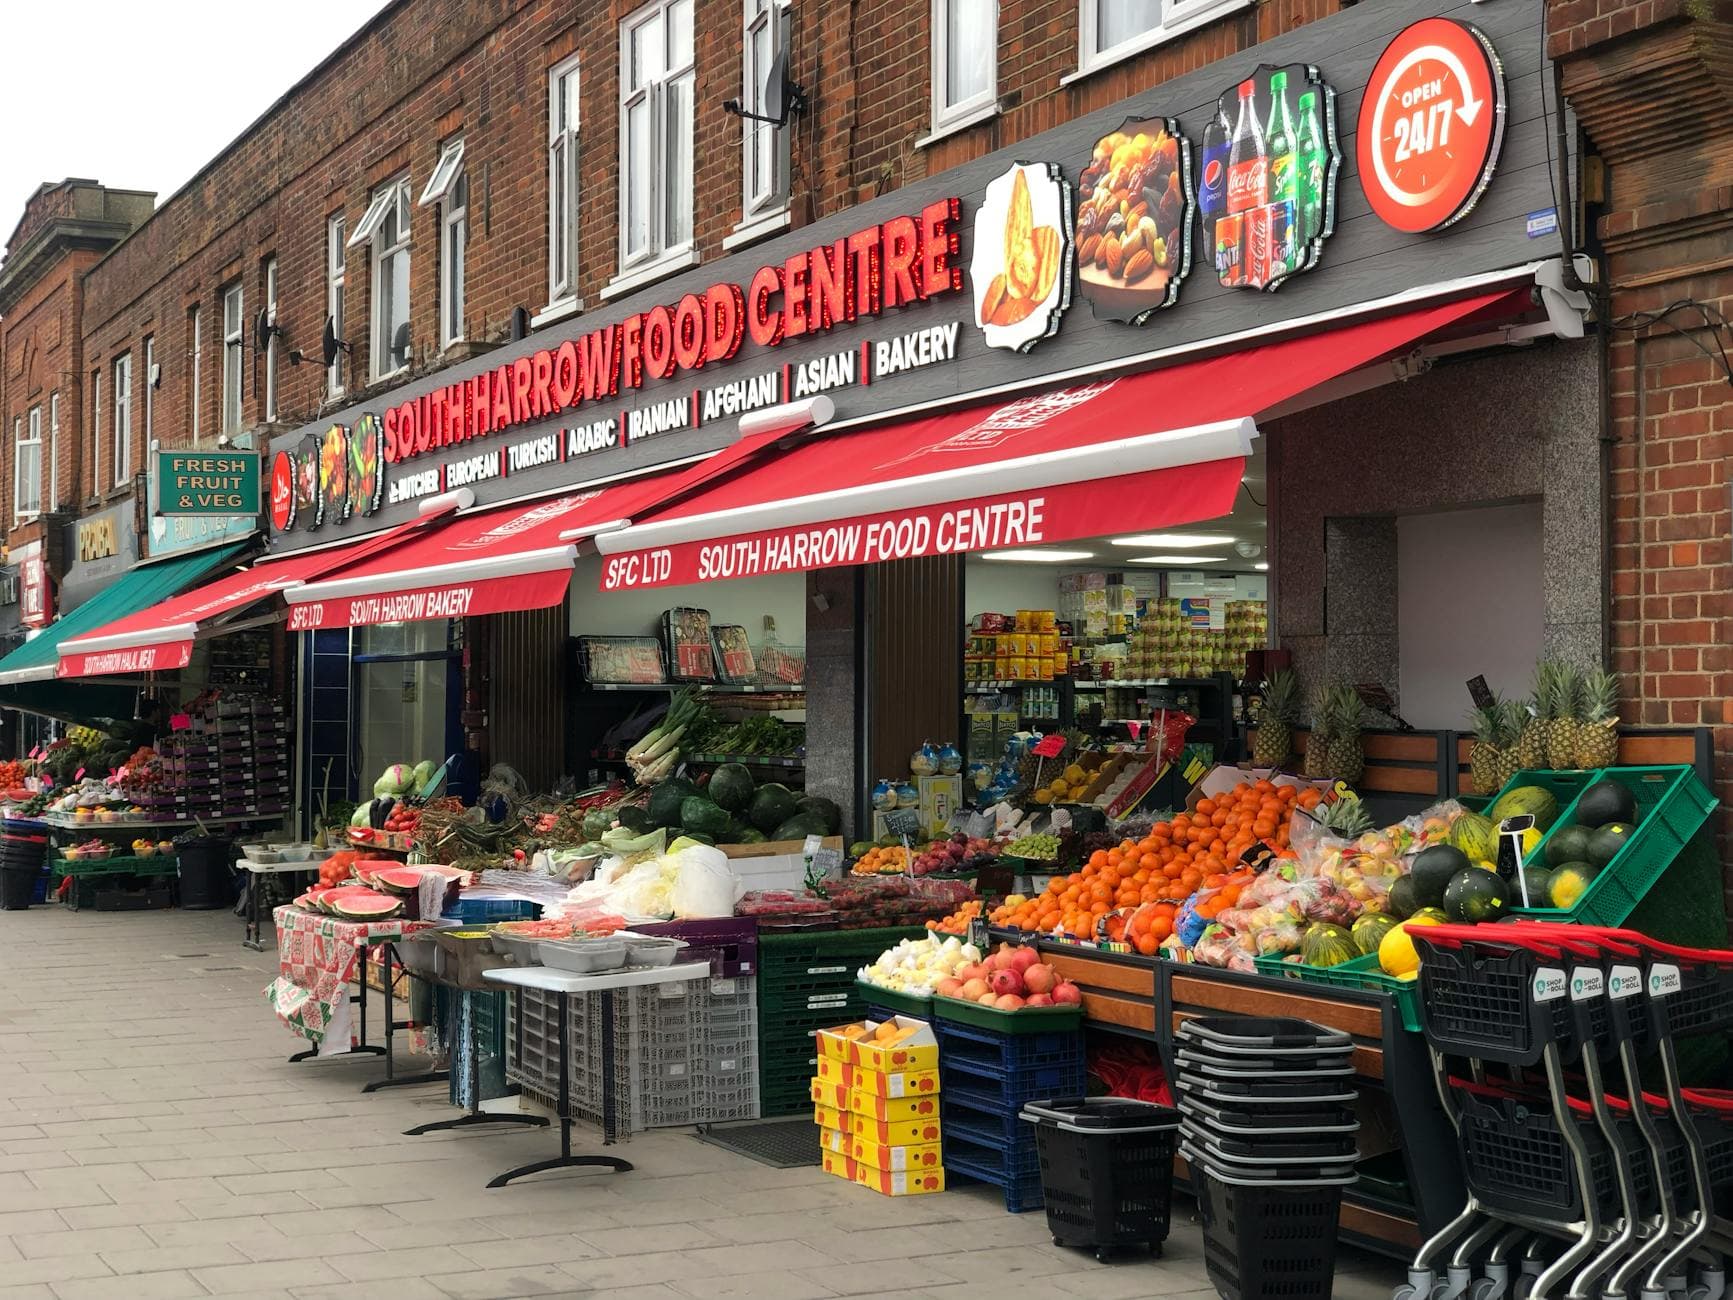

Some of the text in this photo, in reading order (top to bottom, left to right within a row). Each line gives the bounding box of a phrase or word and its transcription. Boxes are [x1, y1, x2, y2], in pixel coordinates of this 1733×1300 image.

[1401, 79, 1442, 109] OPEN
[1394, 98, 1453, 163] 24/7
[623, 283, 746, 389] FOOD
[749, 197, 962, 348] CENTRE
[398, 469, 439, 501] BUTCHER
[446, 451, 499, 489] EUROPEAN
[508, 433, 558, 472] TURKISH
[568, 418, 616, 457] ARABIC
[629, 396, 689, 440] IRANIAN
[703, 371, 779, 421] AFGHANI
[795, 350, 856, 397] ASIAN
[875, 322, 961, 377] BAKERY
[173, 459, 246, 473] FRESH
[177, 476, 243, 490] FRUIT
[179, 494, 243, 508] & VEG
[605, 497, 1046, 589] SFC LTD SOUTH HARROW FOOD CENTRE
[291, 587, 474, 629] SFC LTD SOUTH HARROW BAKERY
[1546, 978, 1562, 987] SHOP
[1583, 977, 1600, 986] SHOP
[1621, 975, 1637, 984] SHOP
[1661, 973, 1676, 983] SHOP
